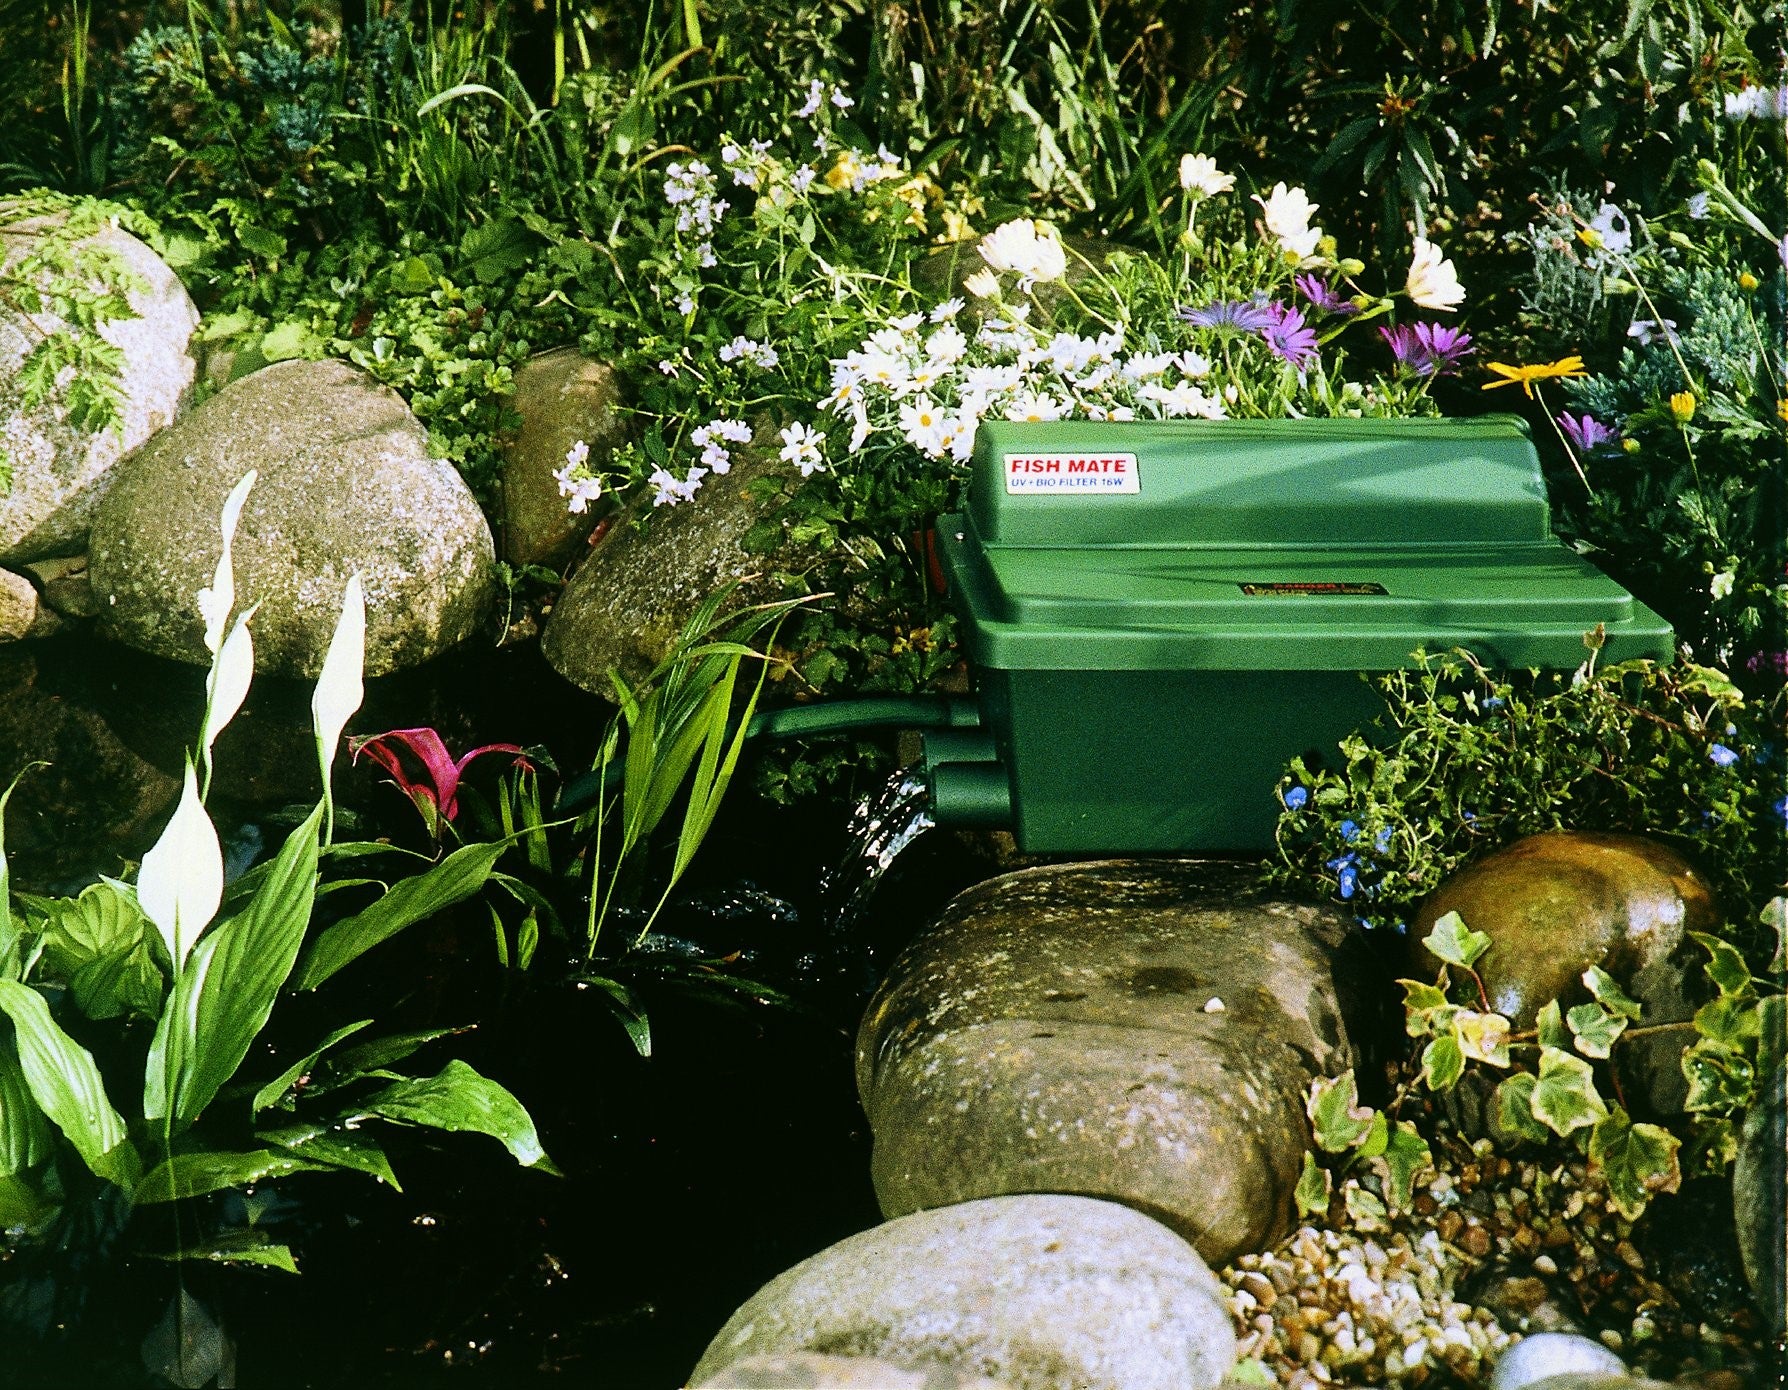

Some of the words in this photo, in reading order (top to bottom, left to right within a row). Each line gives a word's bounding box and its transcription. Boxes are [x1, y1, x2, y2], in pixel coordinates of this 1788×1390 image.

[1011, 459, 1060, 473] FISH
[1068, 459, 1126, 473] MATE
[1011, 478, 1027, 487] UV
[1036, 478, 1056, 487] BIO
[1058, 478, 1097, 487] FILTER
